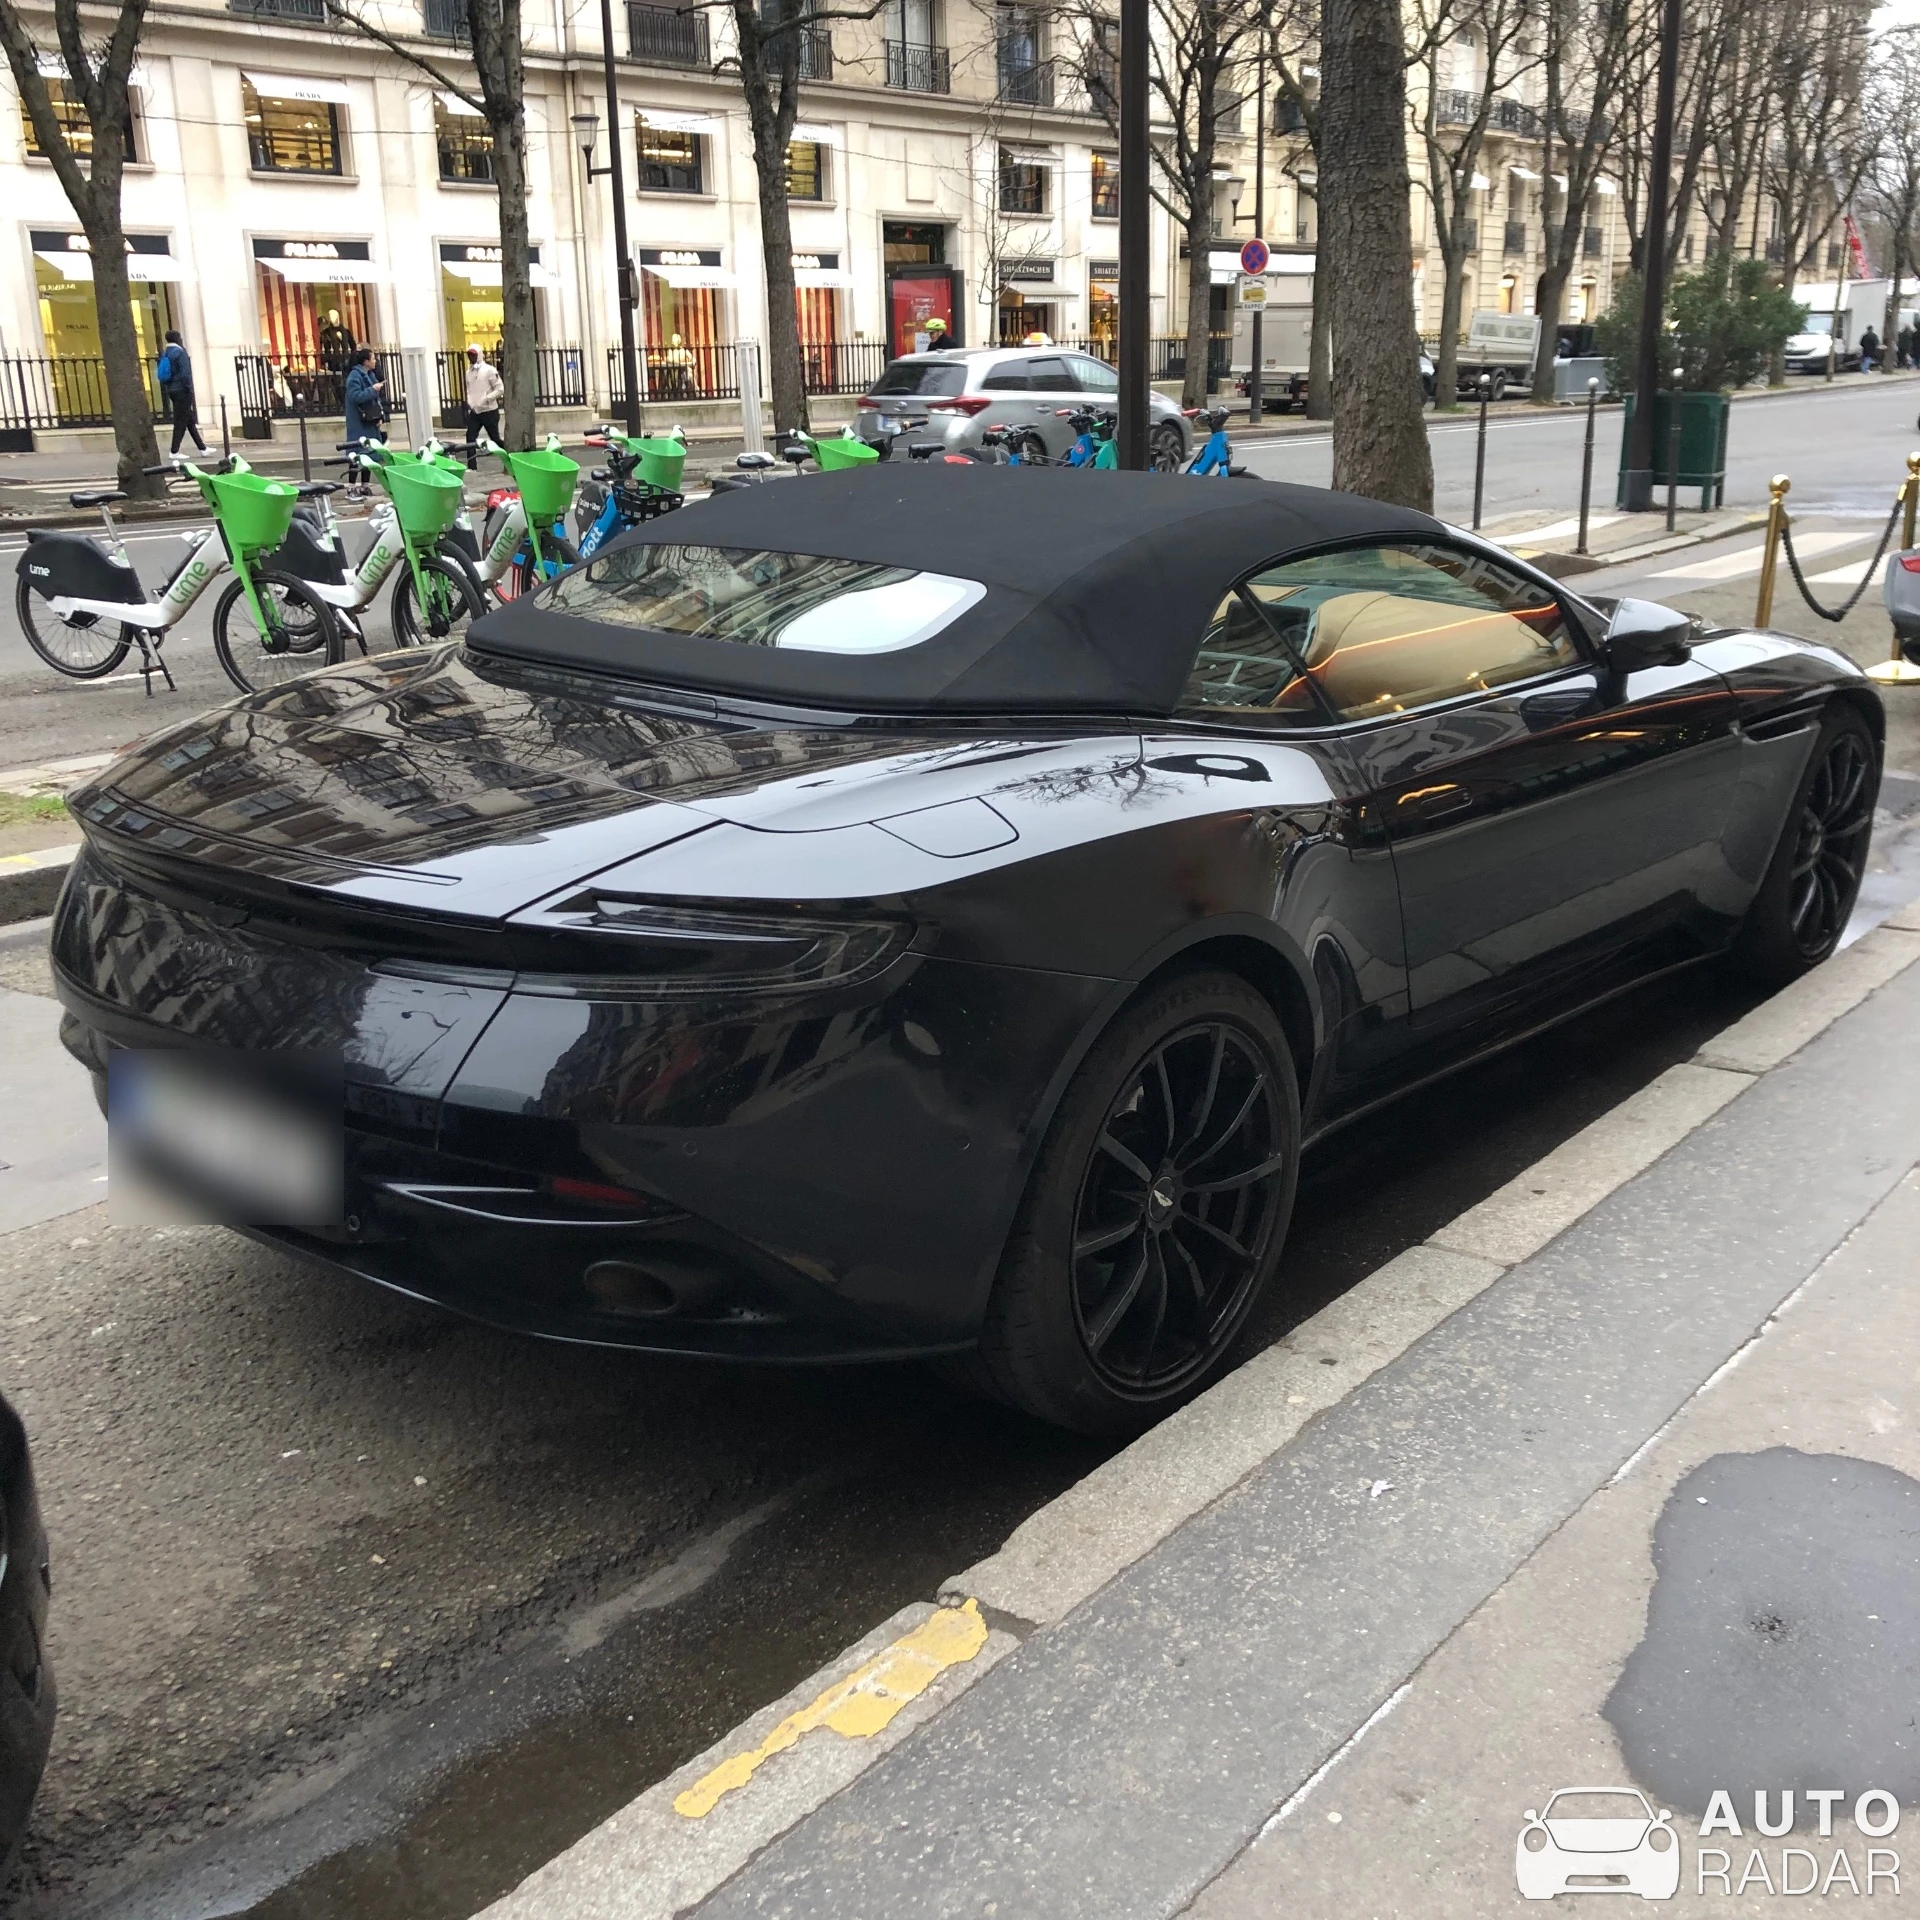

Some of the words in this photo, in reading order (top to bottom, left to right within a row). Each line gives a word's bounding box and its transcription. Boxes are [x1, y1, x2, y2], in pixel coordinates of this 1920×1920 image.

[295, 91, 321, 99] PRADA
[283, 242, 339, 258] PRADA
[466, 246, 503, 261] PRAD
[660, 251, 701, 265] PRADA
[791, 254, 821, 268] RADA
[490, 526, 518, 564] Lime
[29, 563, 51, 577] Lime
[359, 545, 392, 586] Lime
[168, 560, 210, 605] Lime
